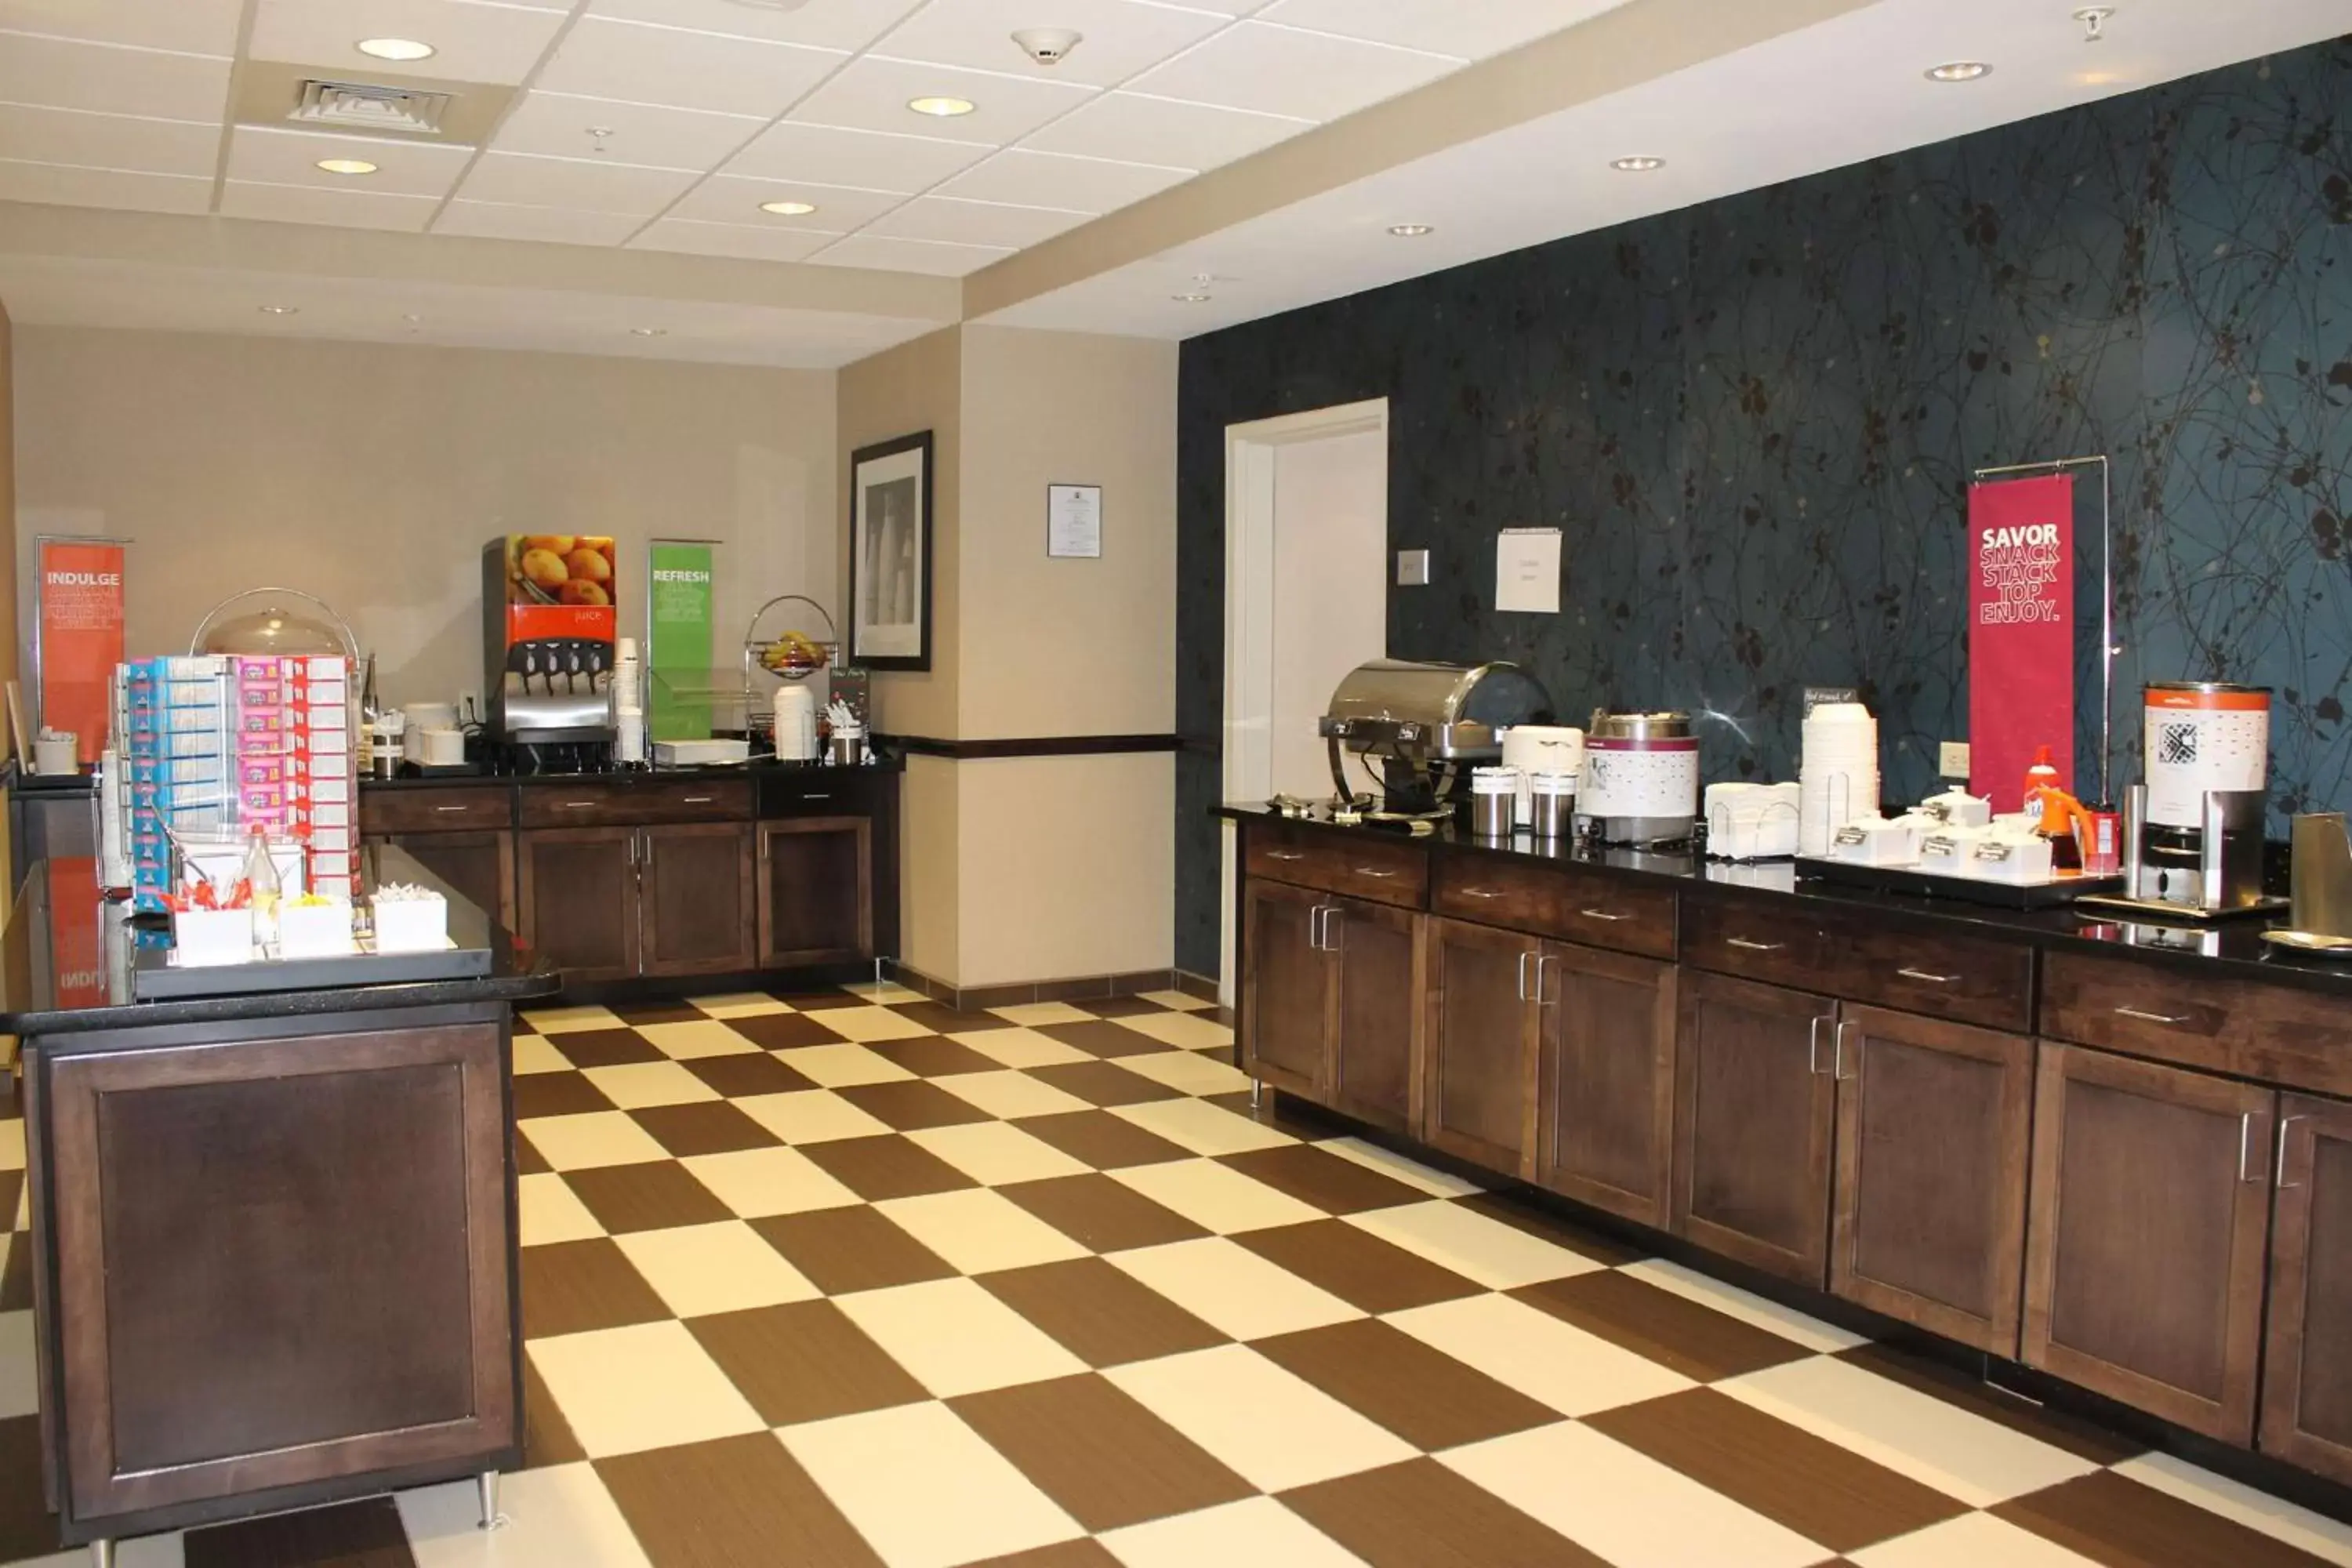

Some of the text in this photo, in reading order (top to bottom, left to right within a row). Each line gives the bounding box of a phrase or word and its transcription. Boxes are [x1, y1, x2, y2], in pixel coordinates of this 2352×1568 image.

[1982, 524, 2057, 549] SAVOR
[1980, 542, 2061, 568] SNACK
[47, 572, 120, 586] INDULGE
[653, 570, 710, 583] REFRESH
[1983, 563, 2057, 587] STACK
[1997, 581, 2042, 603] TOP
[575, 609, 603, 624] juice
[1980, 599, 2060, 624] ENJOY.
